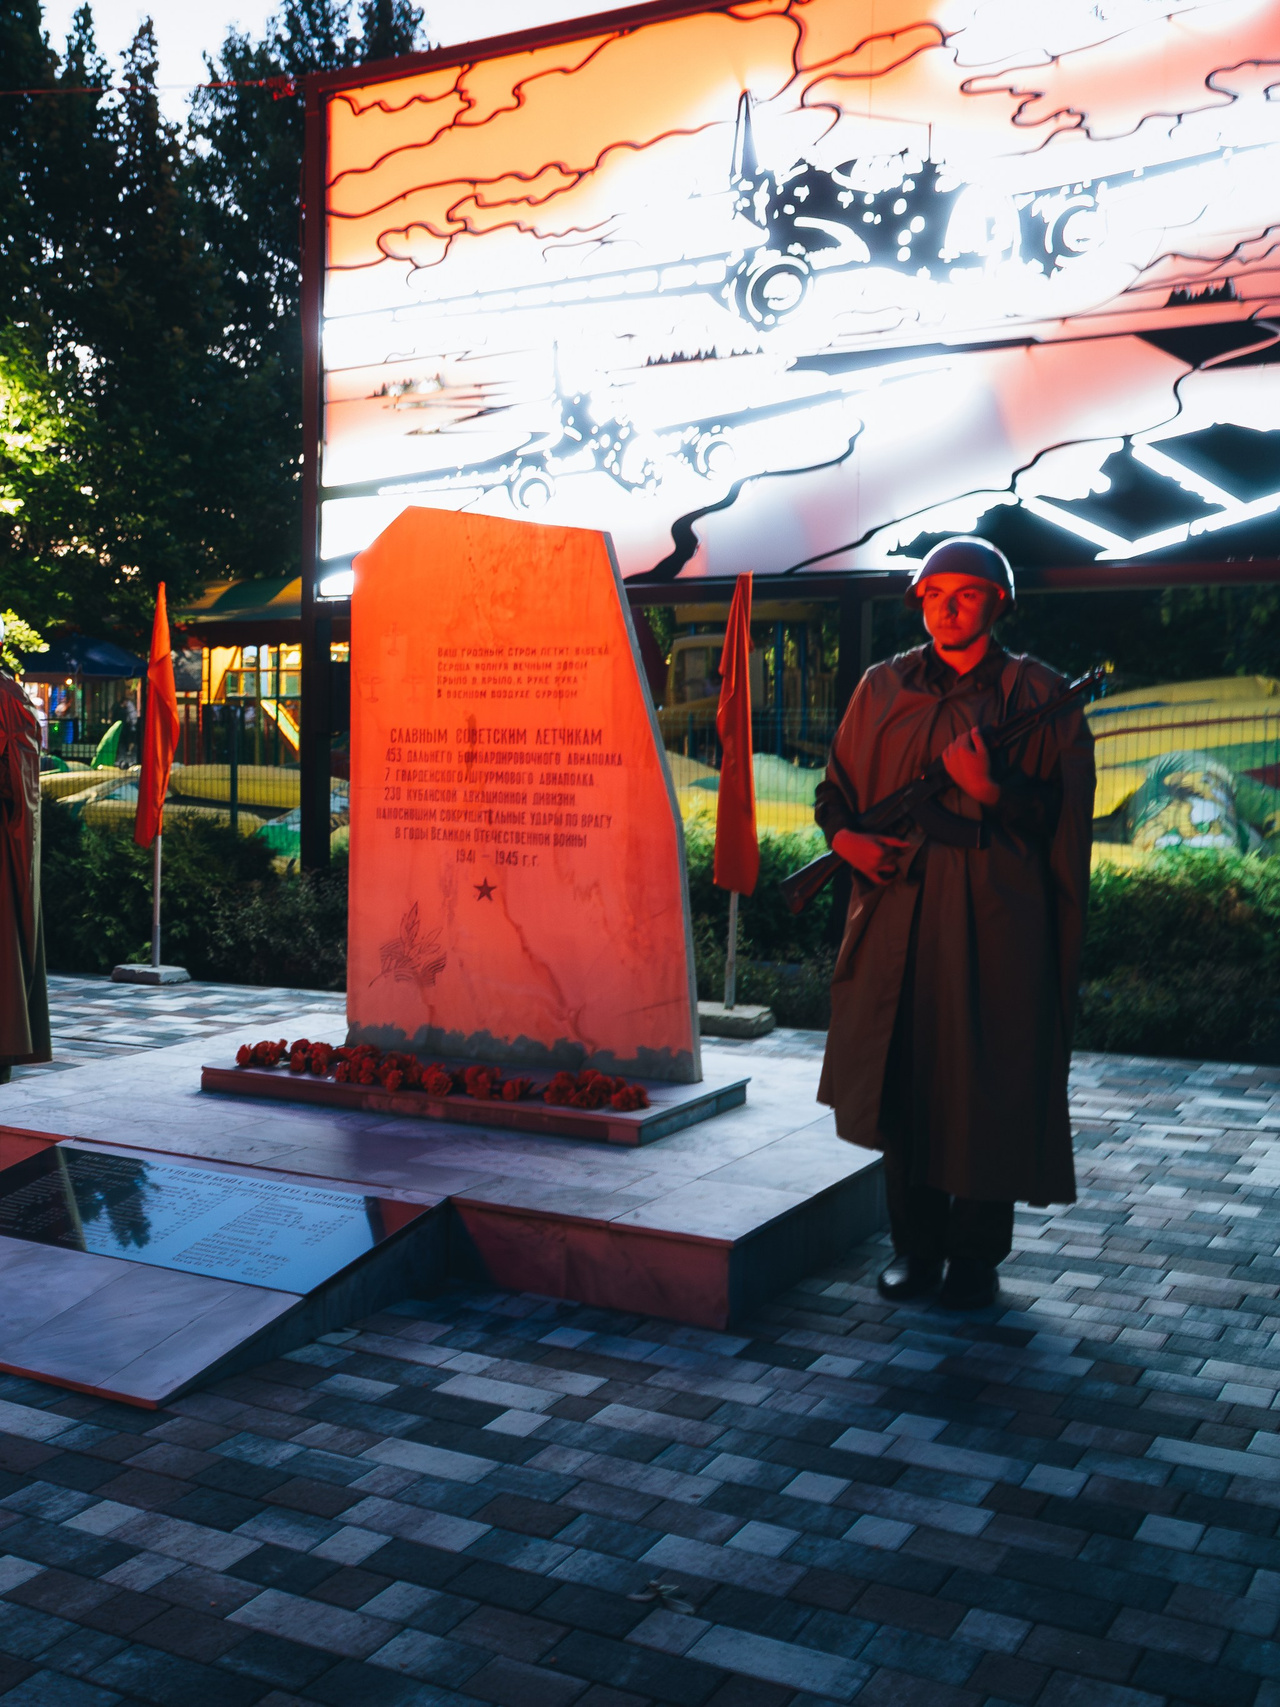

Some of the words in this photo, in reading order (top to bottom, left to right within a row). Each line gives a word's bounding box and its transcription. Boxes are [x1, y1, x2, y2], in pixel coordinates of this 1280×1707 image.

[390, 728, 448, 744] СЛАВНЫМ
[456, 728, 527, 745] СОВЕТСКИМ
[535, 728, 602, 746] ЛЕТЧИКАМ
[407, 750, 452, 764] ДАЛЬНЕГО
[567, 752, 623, 767] АВИАПОЛКА
[384, 767, 391, 782] 7
[539, 772, 594, 787] АВИАПОЛКА
[440, 808, 526, 826] СОКРУШИТЕЛЬНЫЕ
[530, 812, 563, 826] УДАРЫ
[565, 813, 578, 827] ПО
[581, 813, 612, 829] ВРАГУ
[395, 826, 401, 840] В
[404, 827, 428, 841] ГОДЫ
[456, 848, 476, 864] 1941
[495, 850, 519, 867] 1945
